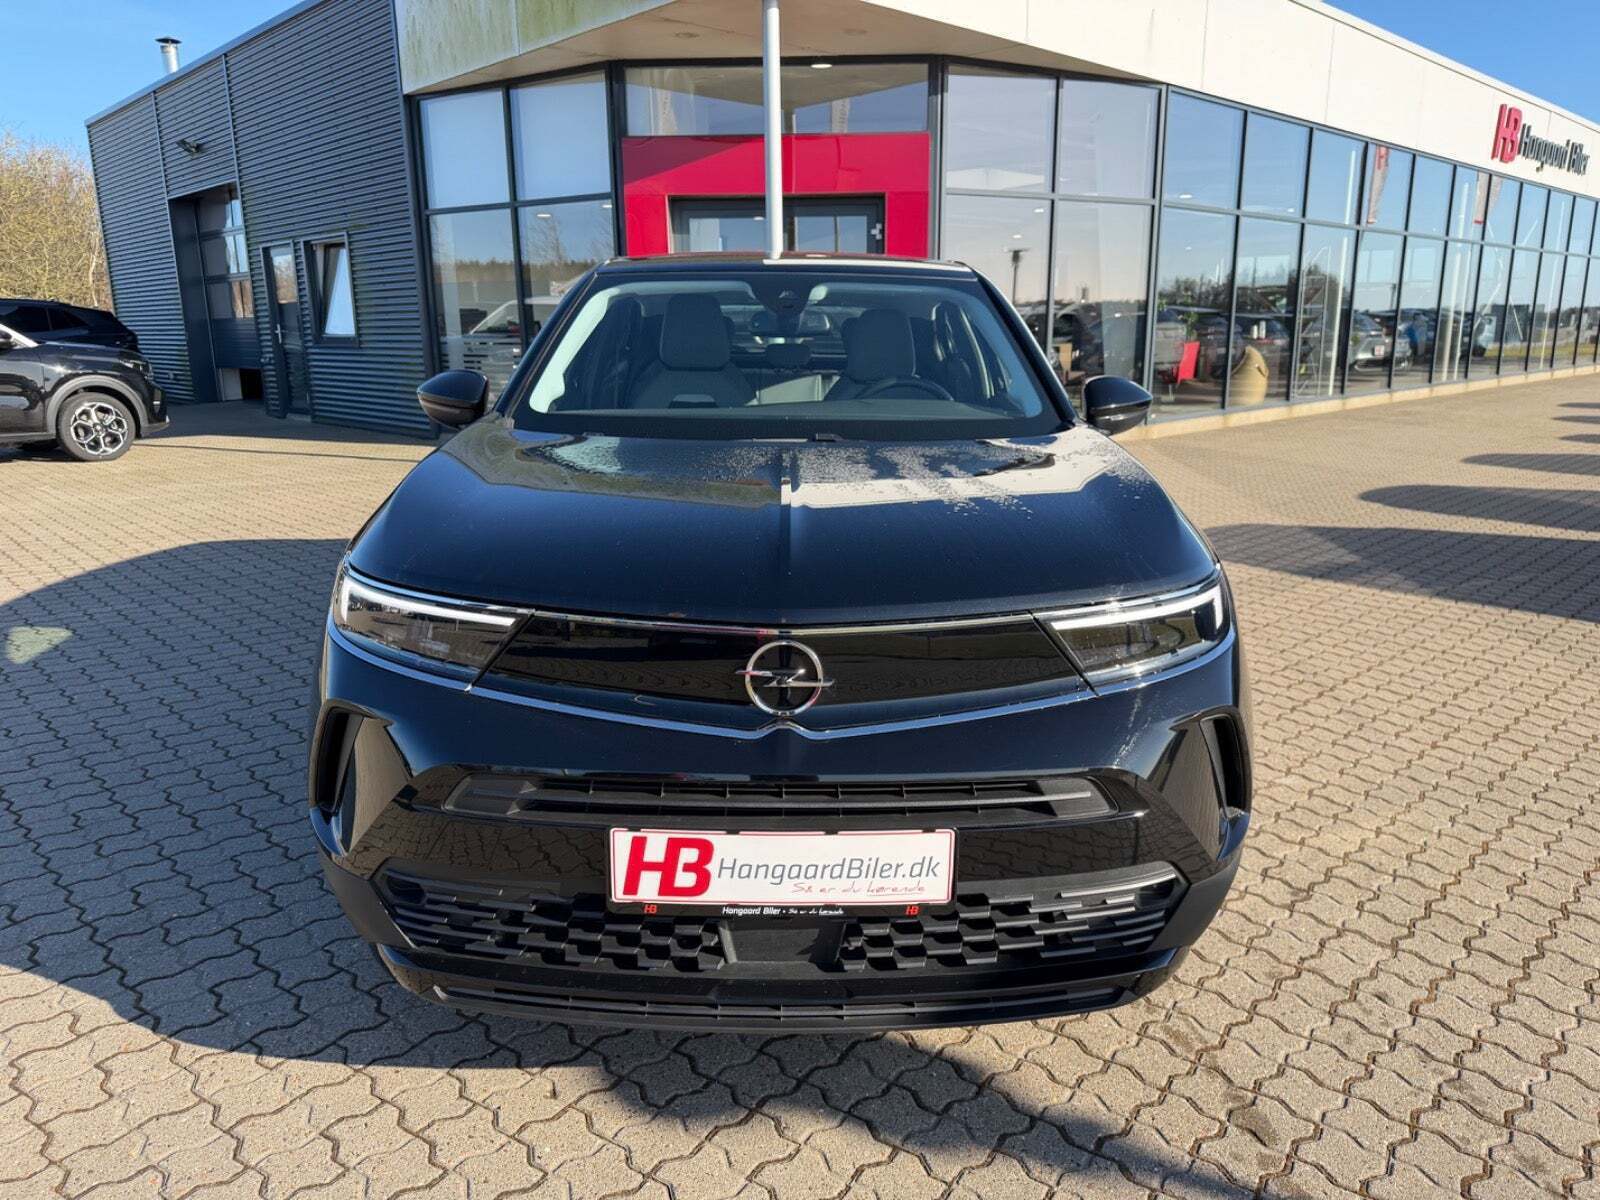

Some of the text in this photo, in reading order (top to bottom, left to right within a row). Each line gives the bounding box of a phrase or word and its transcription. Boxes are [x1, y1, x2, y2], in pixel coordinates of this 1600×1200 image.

[1491, 103, 1522, 163] HB
[622, 835, 940, 898] HB HangaardBiler.dk
[644, 904, 657, 914] HB
[722, 906, 761, 916] Hangaard
[763, 906, 781, 915] Biler
[906, 904, 920, 916] HB
